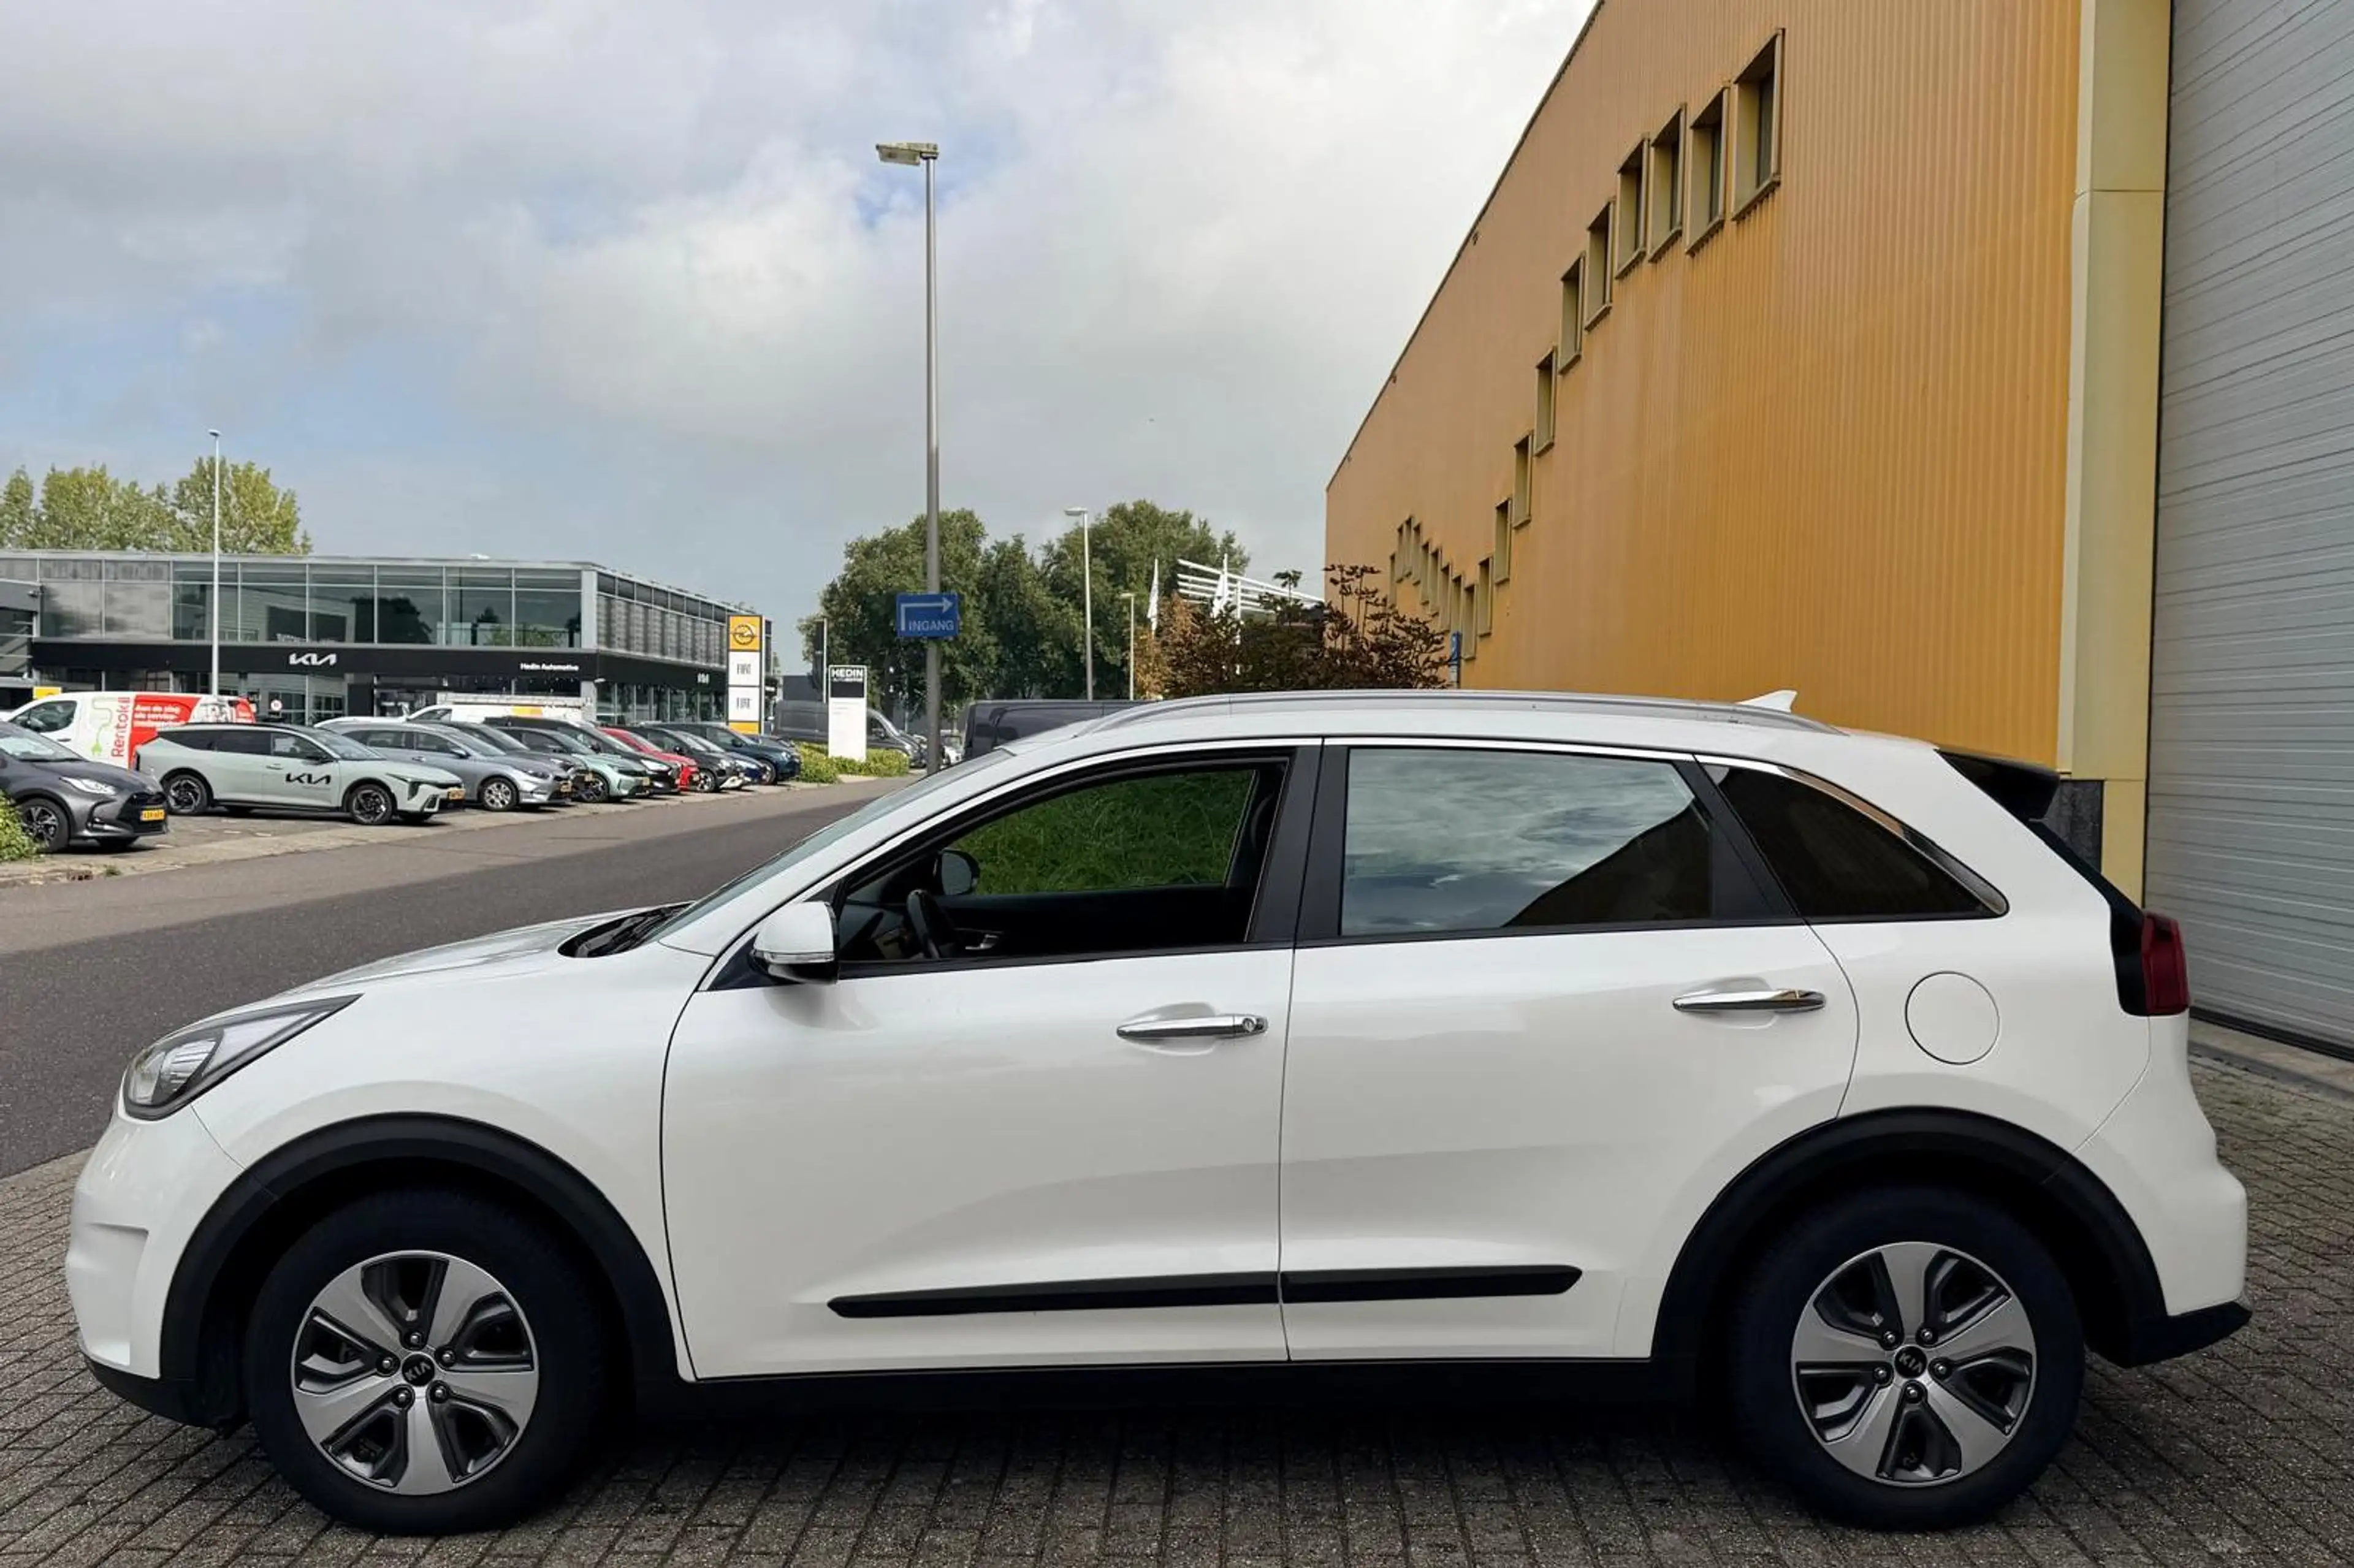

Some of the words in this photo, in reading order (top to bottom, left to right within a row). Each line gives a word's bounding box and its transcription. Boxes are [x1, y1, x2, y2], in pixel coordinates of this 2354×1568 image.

[909, 620, 954, 631] INGANG
[289, 652, 337, 666] KIA
[831, 669, 863, 677] HEDIN
[286, 773, 331, 785] KIA
[1899, 1353, 1922, 1373] KIA
[405, 1361, 431, 1381] KIA
